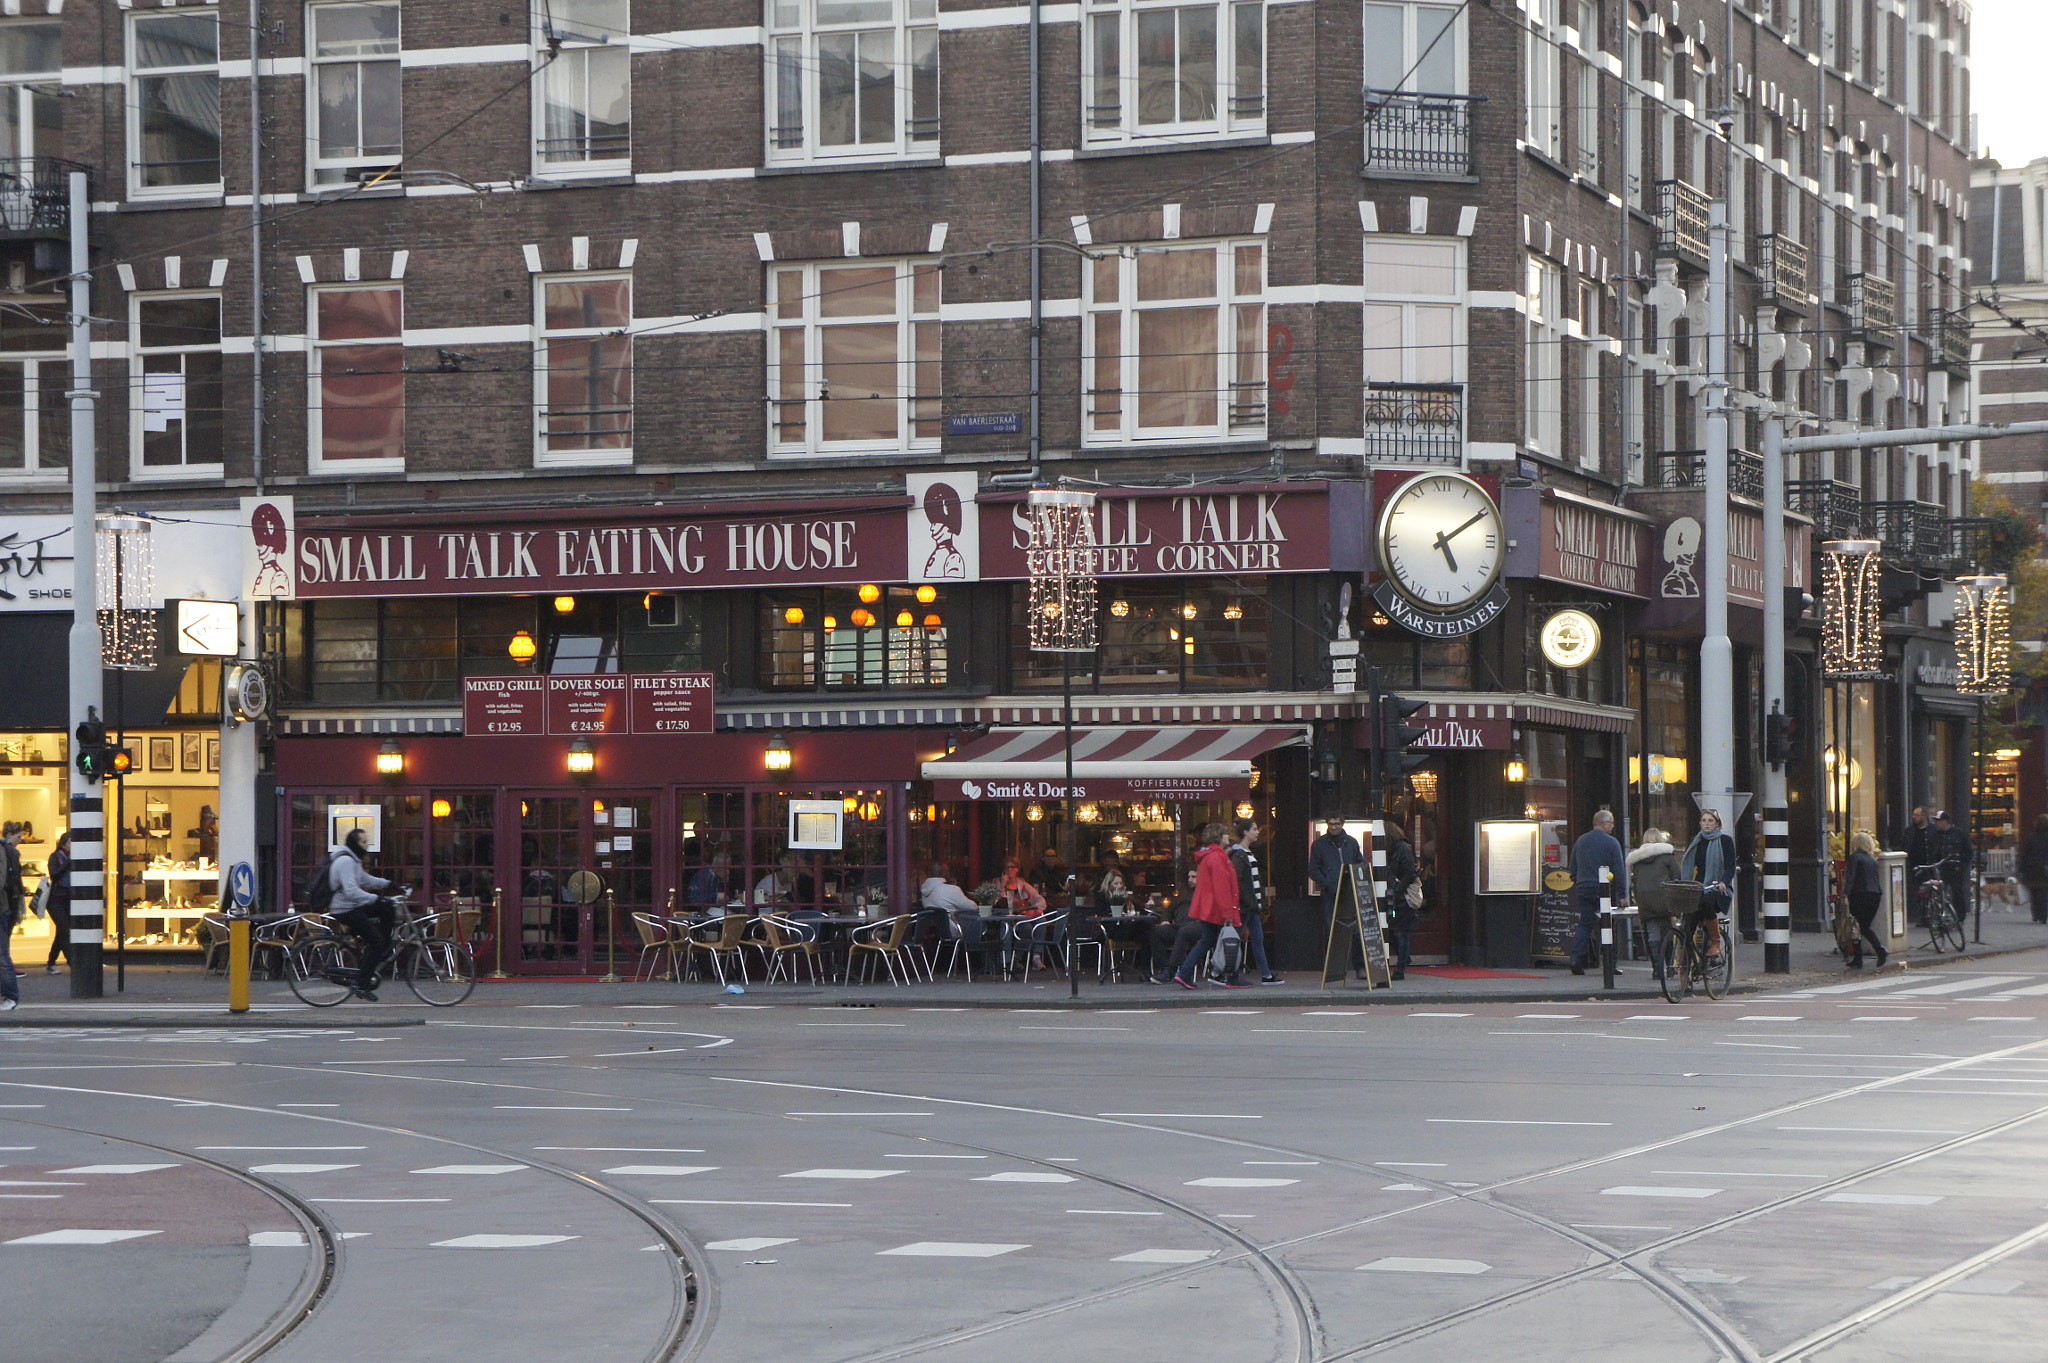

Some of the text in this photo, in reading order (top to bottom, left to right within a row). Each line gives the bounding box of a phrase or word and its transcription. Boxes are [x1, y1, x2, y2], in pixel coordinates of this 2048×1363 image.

[953, 415, 1017, 425] VAN BAERLESTRAAT
[1012, 493, 1288, 549] SMALL TALK
[1555, 503, 1638, 568] SMALL TALK
[1727, 511, 1758, 561] MALL
[300, 520, 858, 584] SMALL TALK EATING HOUSE
[1027, 543, 1282, 575] COFFEE CORNER
[1560, 551, 1636, 593] COFFEE CORNER
[1730, 564, 1765, 593] TRAITE
[28, 588, 74, 599] SHOE
[1390, 593, 1500, 635] WARSTEINER
[466, 680, 543, 691] MIXED GRILL
[550, 679, 625, 690] DOVER SOLE
[633, 677, 711, 689] FILET STEAK
[488, 722, 522, 732] € 12.95
[571, 721, 605, 731] € 24.95
[656, 720, 690, 730] € 17.50
[1445, 721, 1484, 748] TALK
[987, 781, 1086, 798] Smit & Doras
[1127, 779, 1221, 787] KOFFIEBRANDERS
